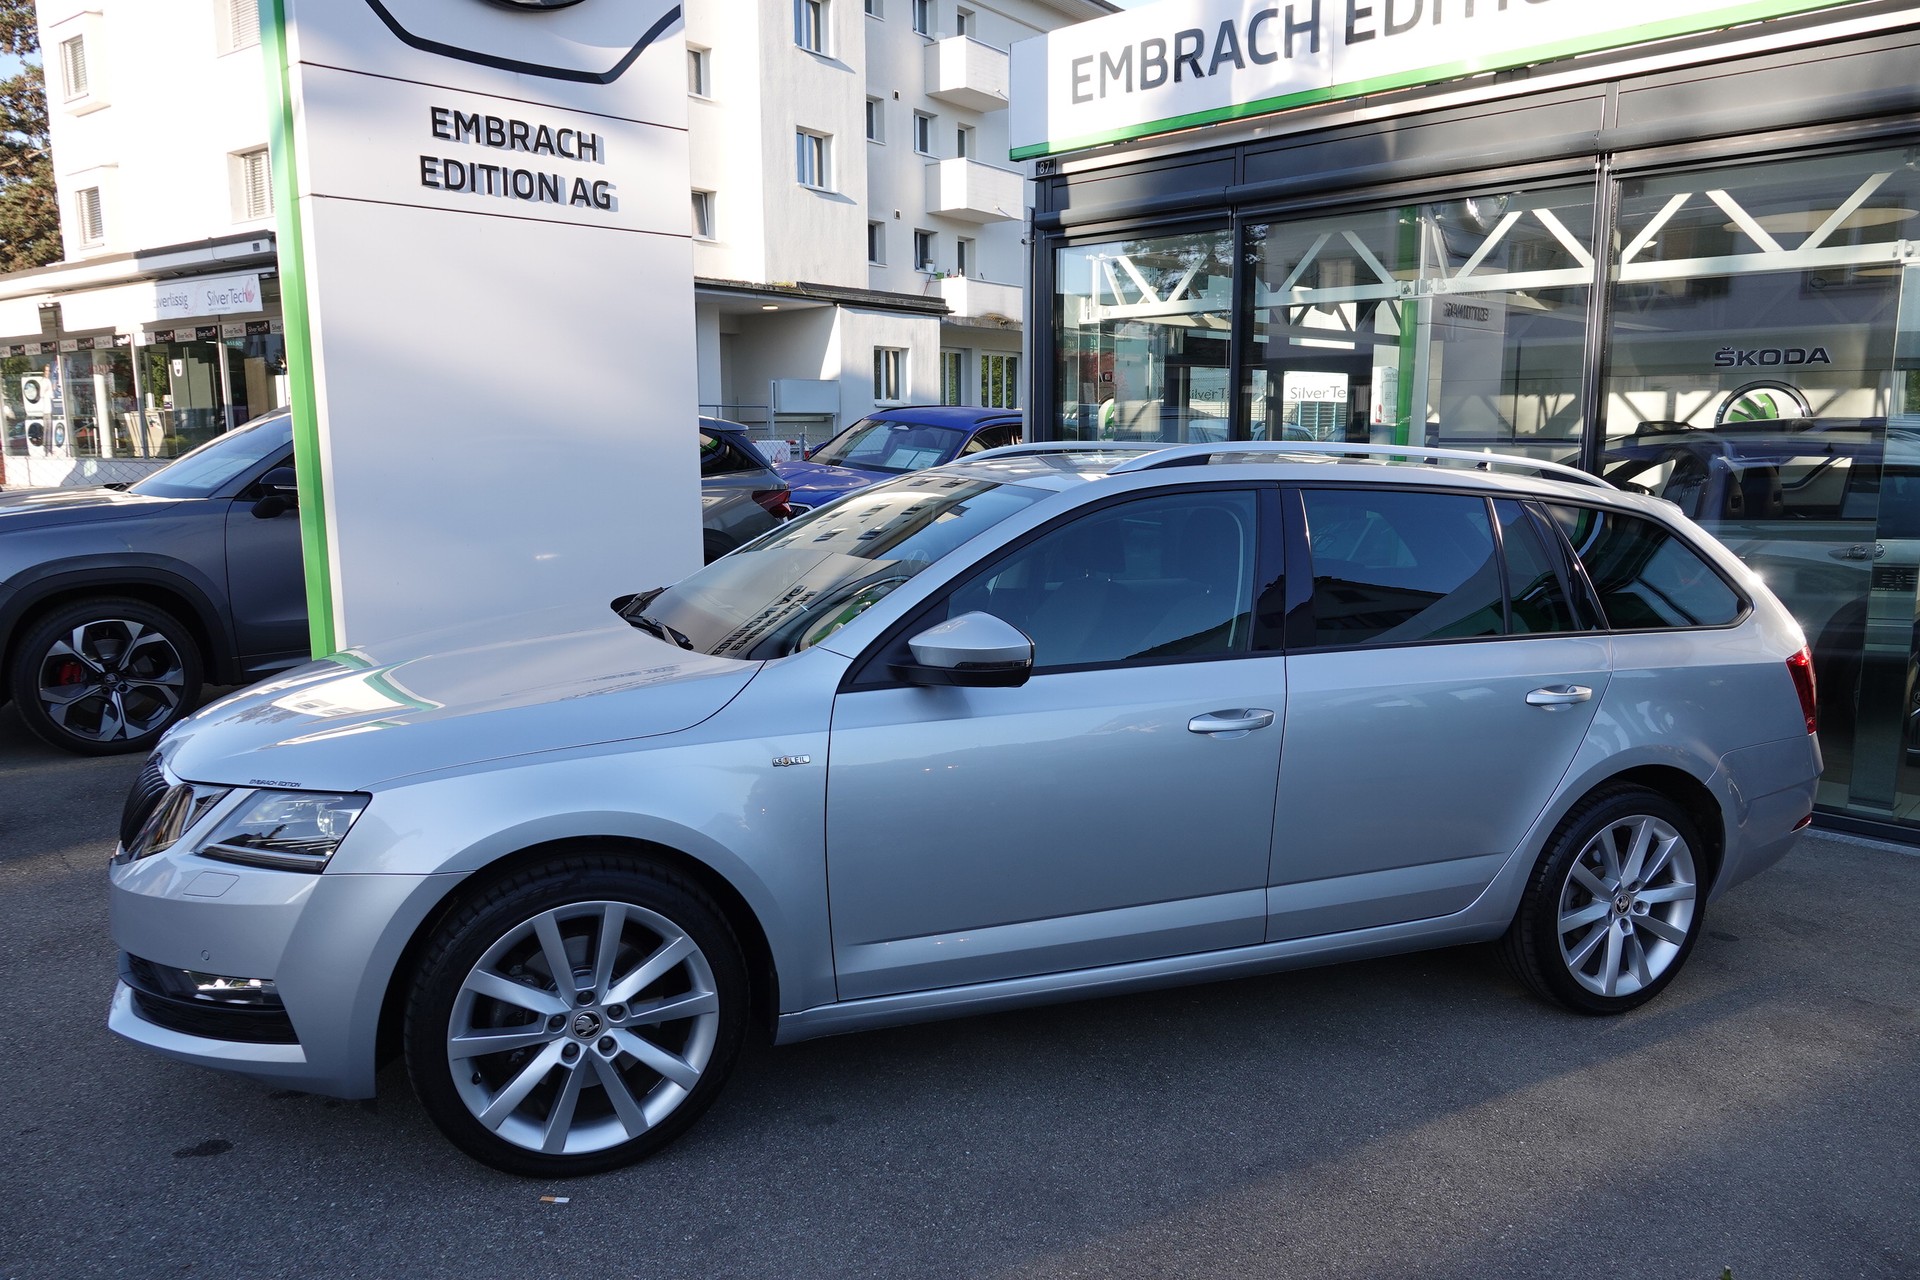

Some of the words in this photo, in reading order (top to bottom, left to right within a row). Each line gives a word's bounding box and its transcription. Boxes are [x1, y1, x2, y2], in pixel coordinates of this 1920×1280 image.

[1071, 0, 1320, 104] EMBRACH
[430, 105, 599, 163] EMBRACH
[419, 154, 560, 203] EDITION
[569, 176, 612, 210] AG
[1039, 161, 1050, 174] 87
[1713, 346, 1832, 367] ŠKODA
